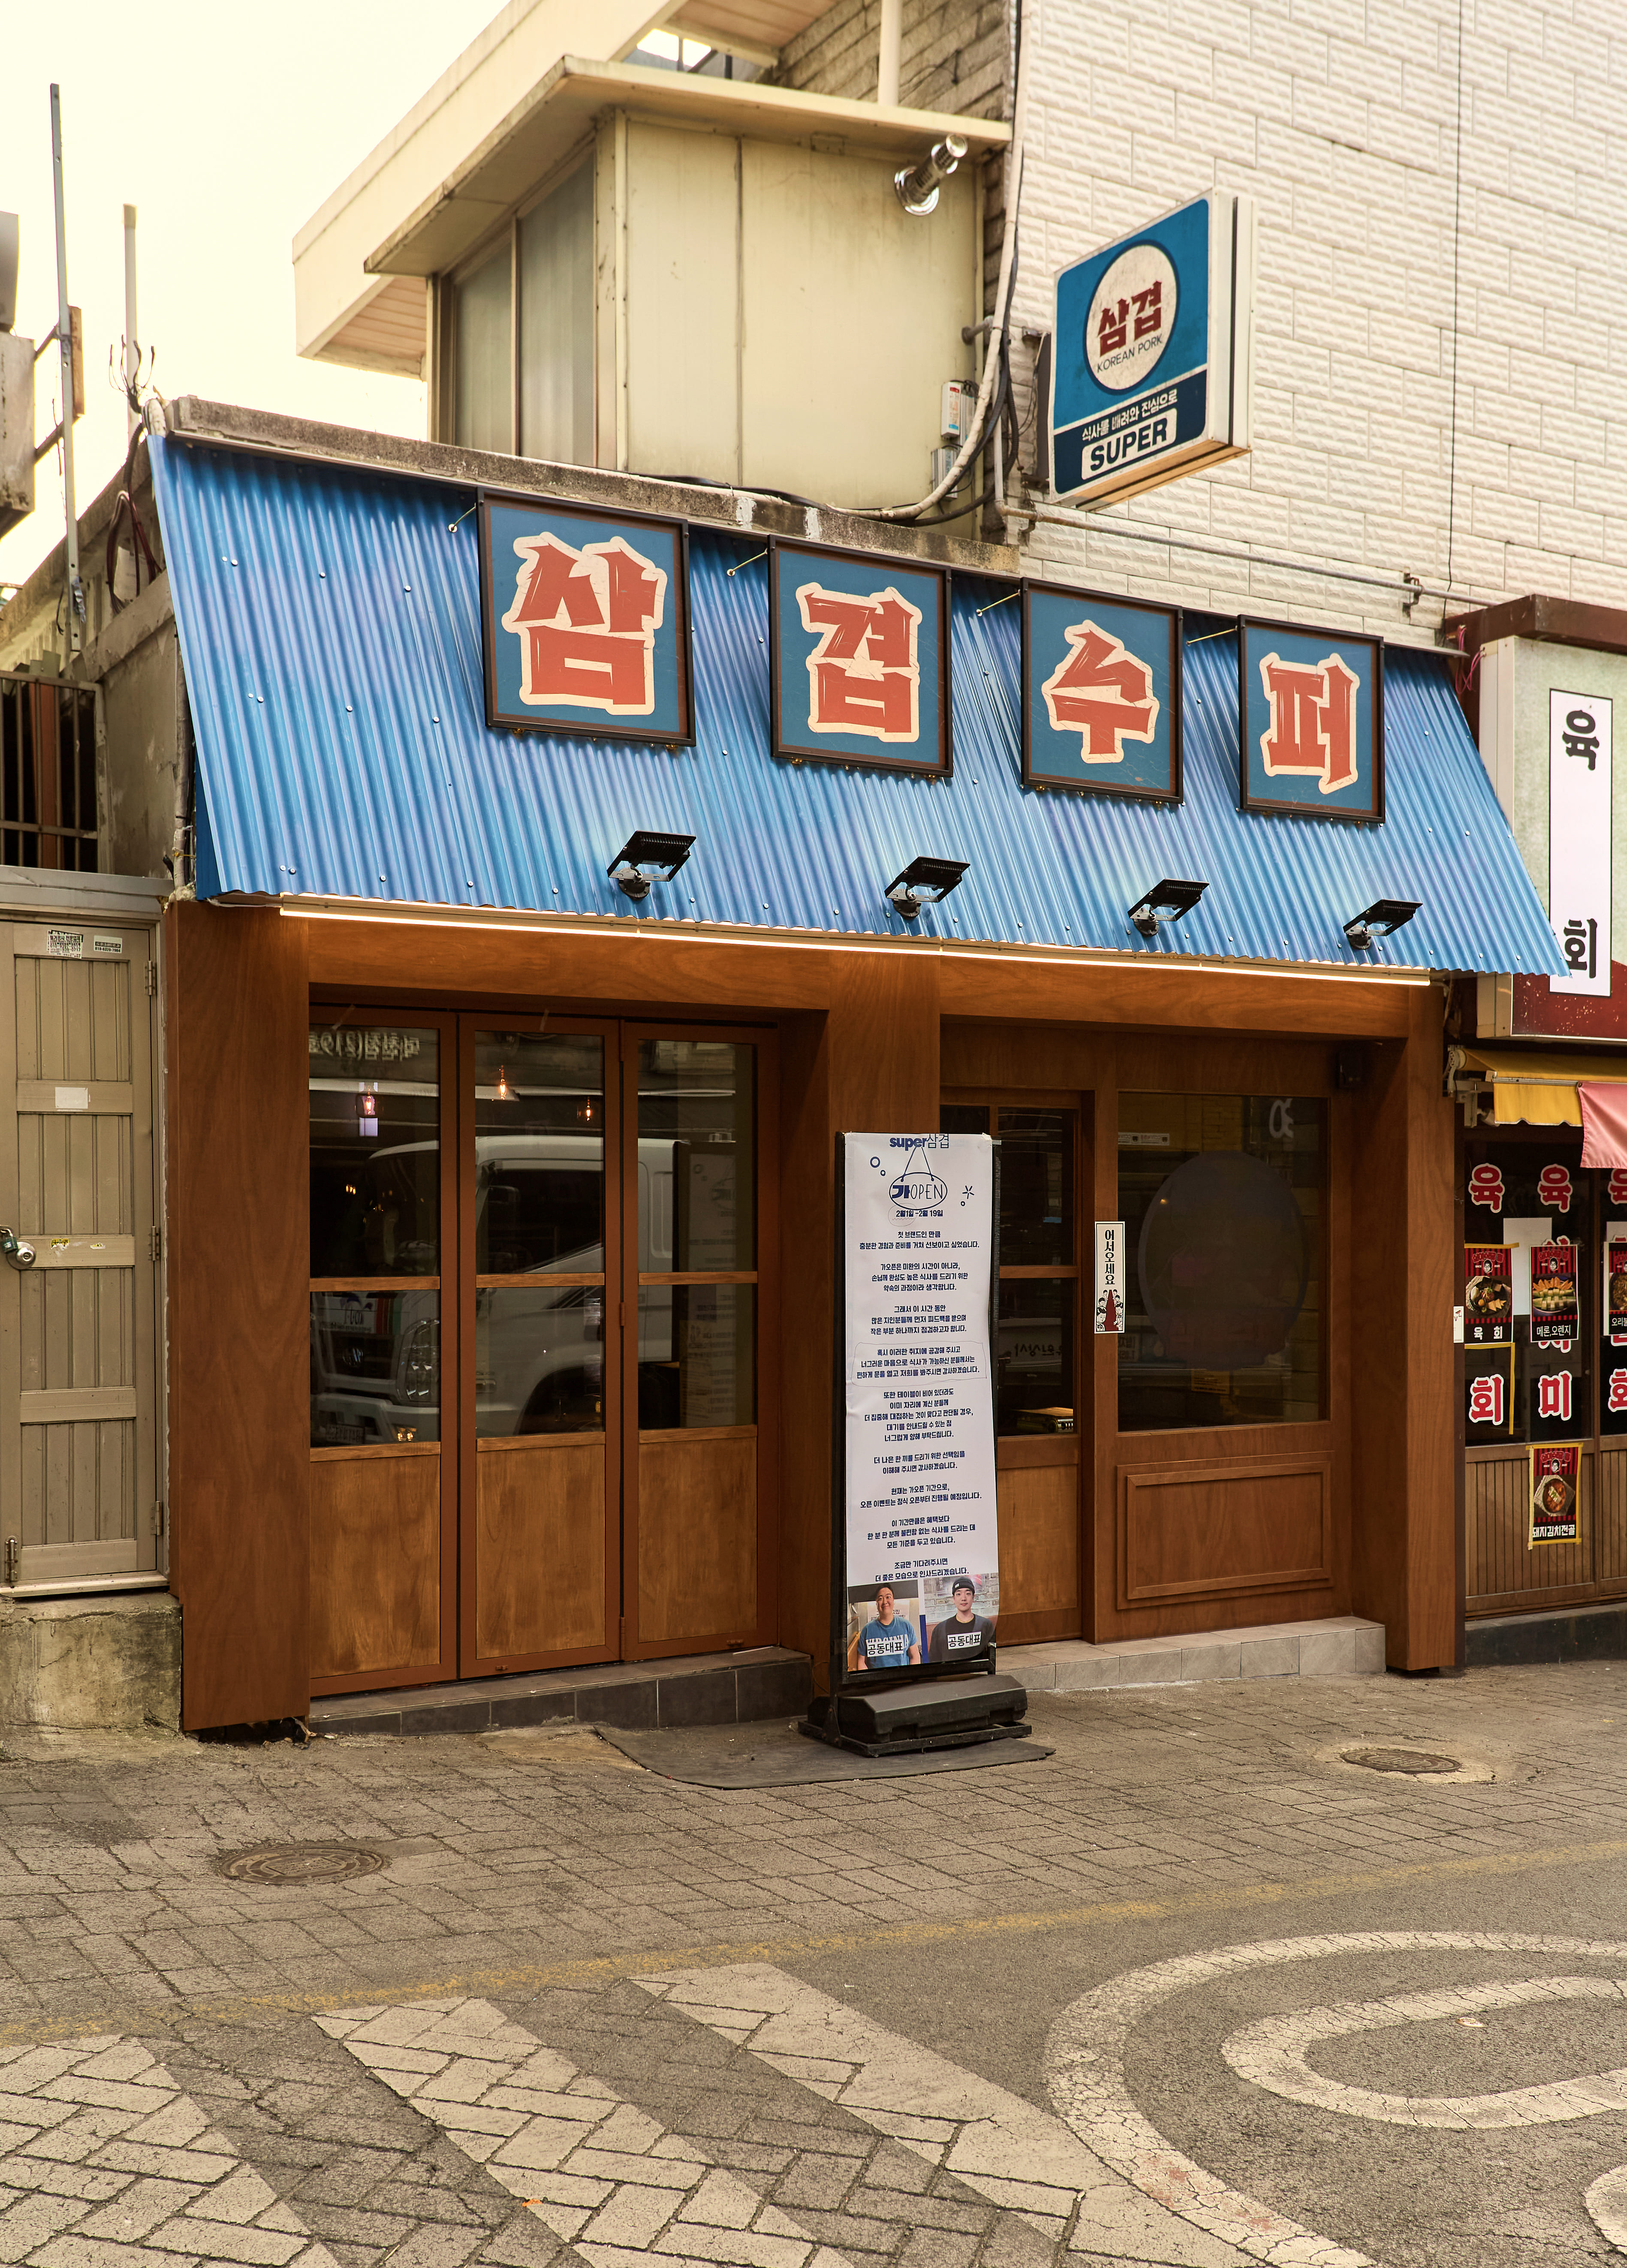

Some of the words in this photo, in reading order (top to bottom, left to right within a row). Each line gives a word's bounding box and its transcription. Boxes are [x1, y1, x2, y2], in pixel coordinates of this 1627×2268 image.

[1098, 280, 1162, 357] 삼겹
[1097, 346, 1135, 373] KOREAN
[1137, 334, 1163, 355] PORK
[1082, 419, 1109, 441] 식사를
[1112, 406, 1139, 430] 배려와
[1142, 389, 1178, 418] 진심으로
[1090, 417, 1168, 471] SUPER
[1562, 709, 1600, 771] 육
[1563, 918, 1598, 979] 회
[1104, 1229, 1115, 1285] 어서오세요
[921, 1325, 949, 1334] 점검하고자
[857, 1371, 873, 1379] 편하게
[943, 1366, 979, 1375] 감사하겠습니다.
[897, 1390, 921, 1398] 테이블이
[934, 1388, 954, 1396] 있더라도
[904, 1401, 921, 1409] 자리에
[871, 1413, 888, 1421] 집중해
[927, 1410, 942, 1418] 맞다고
[943, 1409, 958, 1417] 판단될
[960, 1408, 973, 1416] 경우,
[907, 1422, 927, 1431] 안내드릴
[885, 1434, 908, 1442] 너그럽게
[910, 1433, 920, 1441] 양해
[922, 1430, 954, 1440] 부탁드립니다.
[914, 1453, 929, 1461] 드리기
[943, 1451, 965, 1459] 선택임을
[883, 1466, 900, 1474] 이해해
[901, 1465, 916, 1473] 주시면
[918, 1461, 957, 1472] 감사하겠습니다.
[891, 1487, 907, 1495] 현재는
[909, 1485, 924, 1494] 가오픈
[926, 1483, 949, 1492] 기간으로,
[874, 1499, 896, 1507] 이벤트는
[897, 1497, 908, 1506] 정식
[909, 1495, 930, 1504] 오픈부터
[932, 1494, 948, 1502] 진행될
[950, 1492, 982, 1500] 예정입니다.
[899, 1517, 925, 1526] 기간만큼은
[927, 1515, 950, 1524] 혜택보다
[889, 1530, 899, 1538] 분께
[901, 1528, 917, 1537] 불편함
[931, 1526, 949, 1534] 식사를
[899, 1539, 915, 1548] 기준을
[917, 1538, 928, 1546] 두고
[930, 1536, 955, 1545] 있습니다.
[895, 1561, 911, 1569] 조금만
[913, 1558, 948, 1568] 기다려주시면
[895, 1572, 918, 1580] 모습으로
[920, 1567, 969, 1578] 인사드리겠습니다.
[948, 1634, 981, 1648] 공동대표
[868, 1642, 904, 1655] 공동대표
